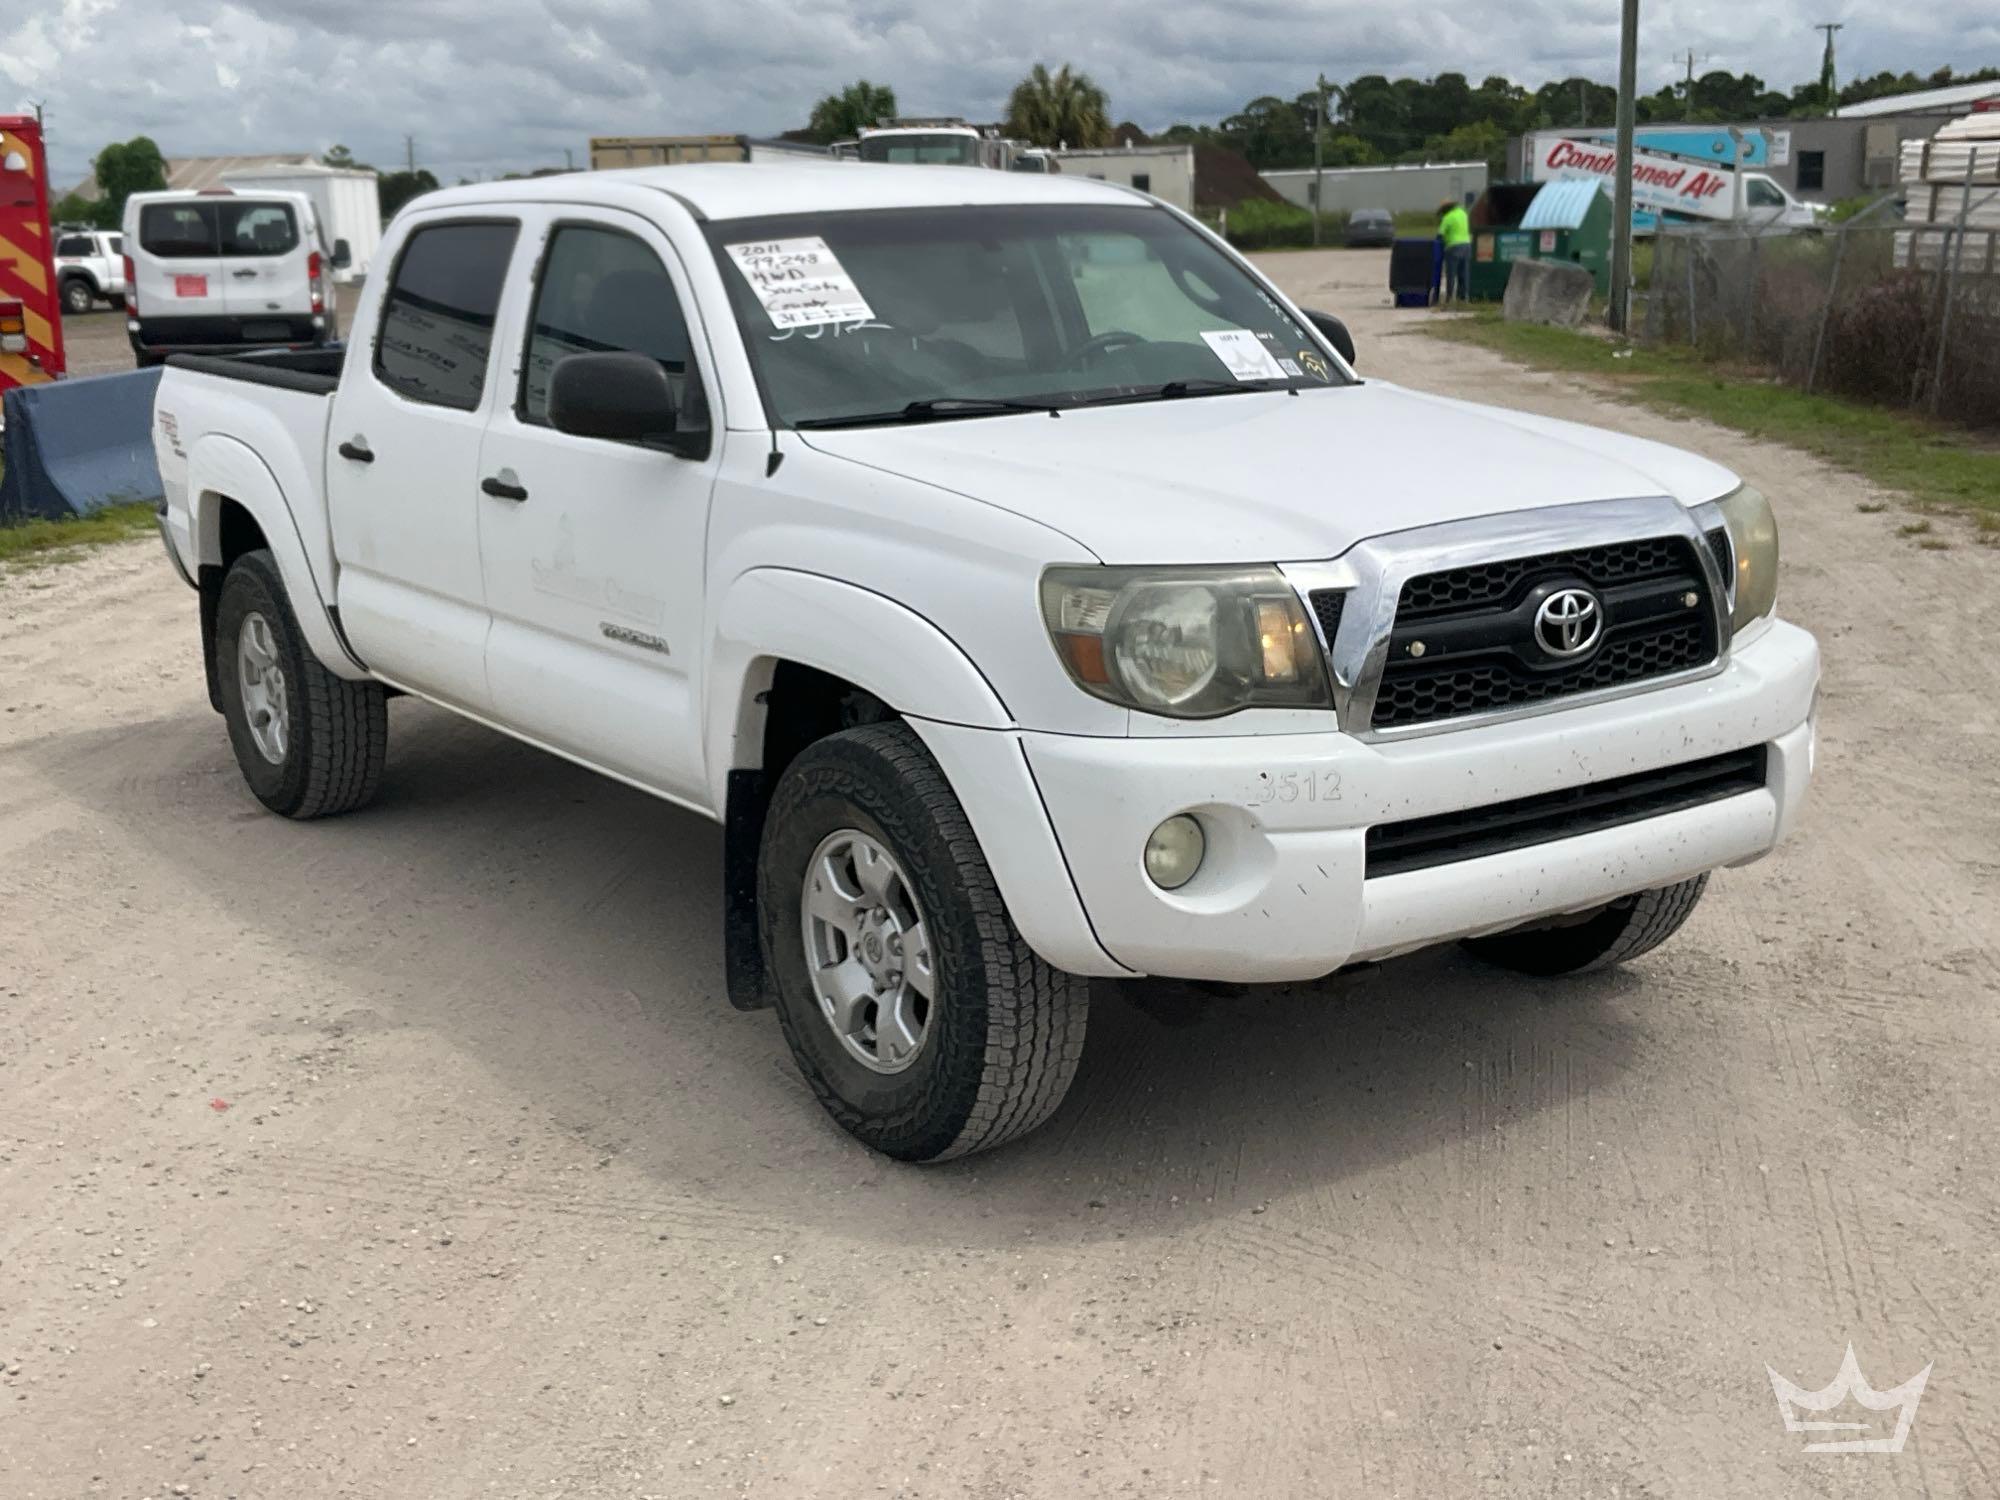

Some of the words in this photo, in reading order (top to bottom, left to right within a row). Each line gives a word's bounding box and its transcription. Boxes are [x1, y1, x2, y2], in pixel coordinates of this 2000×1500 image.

[1546, 141, 1687, 188] Condioned
[1679, 171, 1726, 199] Air
[738, 244, 781, 257] 2011
[1255, 769, 1342, 802] 3512
